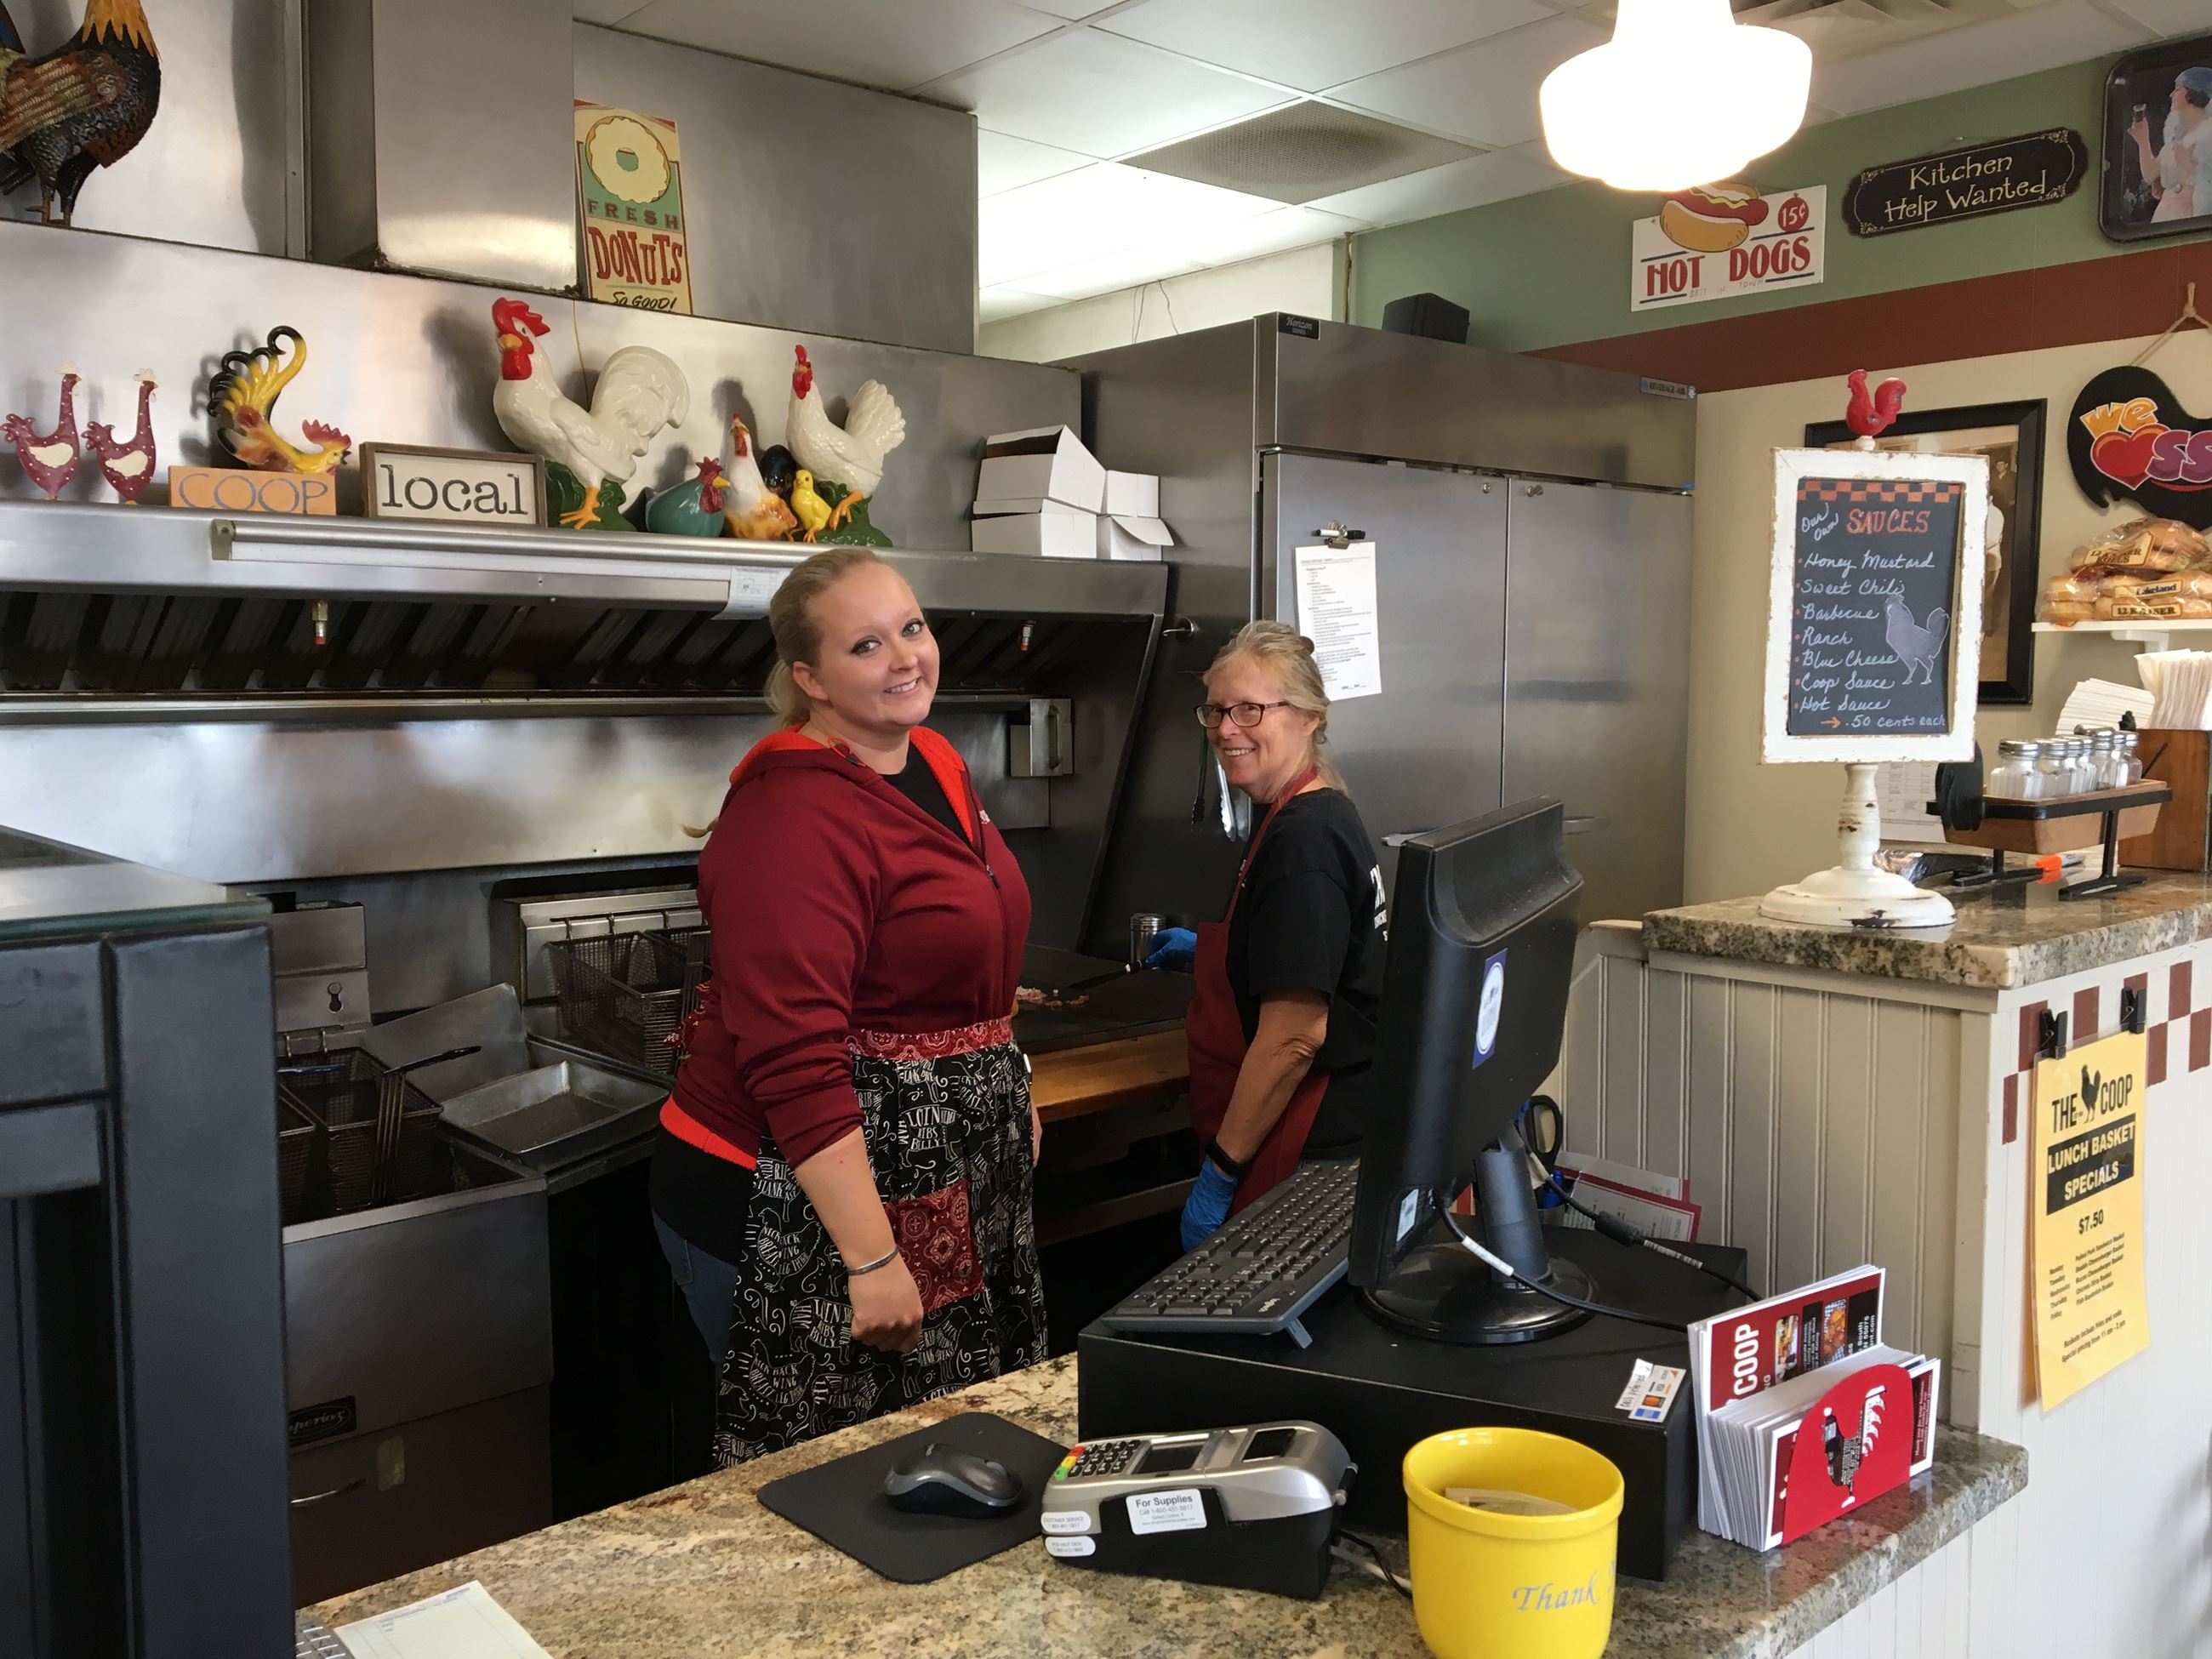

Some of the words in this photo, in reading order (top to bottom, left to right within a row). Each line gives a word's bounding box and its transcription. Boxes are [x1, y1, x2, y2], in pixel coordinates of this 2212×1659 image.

[1909, 156, 2013, 191] Kitchen
[1884, 195, 1937, 222] Help
[1947, 169, 2046, 211] Wanted
[587, 198, 679, 231] FRESH
[1782, 202, 1806, 227] 15¢
[587, 226, 682, 285] DONUTS
[1647, 255, 1706, 296] HOT
[1730, 236, 1810, 282] DOGS
[631, 295, 677, 311] GOOD!
[179, 473, 328, 515] COOP
[380, 464, 528, 516] local
[1801, 502, 1829, 533] Our
[1814, 513, 1839, 541] Own
[1846, 508, 1931, 534] SAUCES
[1804, 552, 1856, 578] Honey
[1861, 549, 1935, 569] Mustard
[1800, 579, 1851, 595] Sweet
[2136, 584, 2177, 596] Lakeland
[1801, 602, 1879, 620] Barbecue
[1802, 626, 1853, 646] Ranch
[1802, 649, 1843, 669] Blue
[1845, 649, 1900, 666] Cheese
[1800, 672, 1839, 693] Coop
[1844, 670, 1896, 689] Sauce
[1799, 696, 1830, 713] Hot
[1838, 694, 1890, 711] Sauce
[1877, 715, 1915, 727] cents
[1919, 715, 1946, 727] each
[907, 1107, 940, 1127] LOIN
[2052, 1093, 2078, 1133] THE
[2101, 1074, 2133, 1115] COOP
[2049, 1141, 2089, 1174] LUNCH
[2092, 1121, 2135, 1156] BASKET
[2064, 1160, 2118, 1200] SPECIALS
[2078, 1209, 2103, 1234] $7.50
[1733, 1323, 1759, 1396] COOP
[772, 1377, 797, 1389] WING
[1136, 1498, 1151, 1508] For
[1153, 1494, 1193, 1508] Supplies
[1512, 1571, 1598, 1611] Thank
